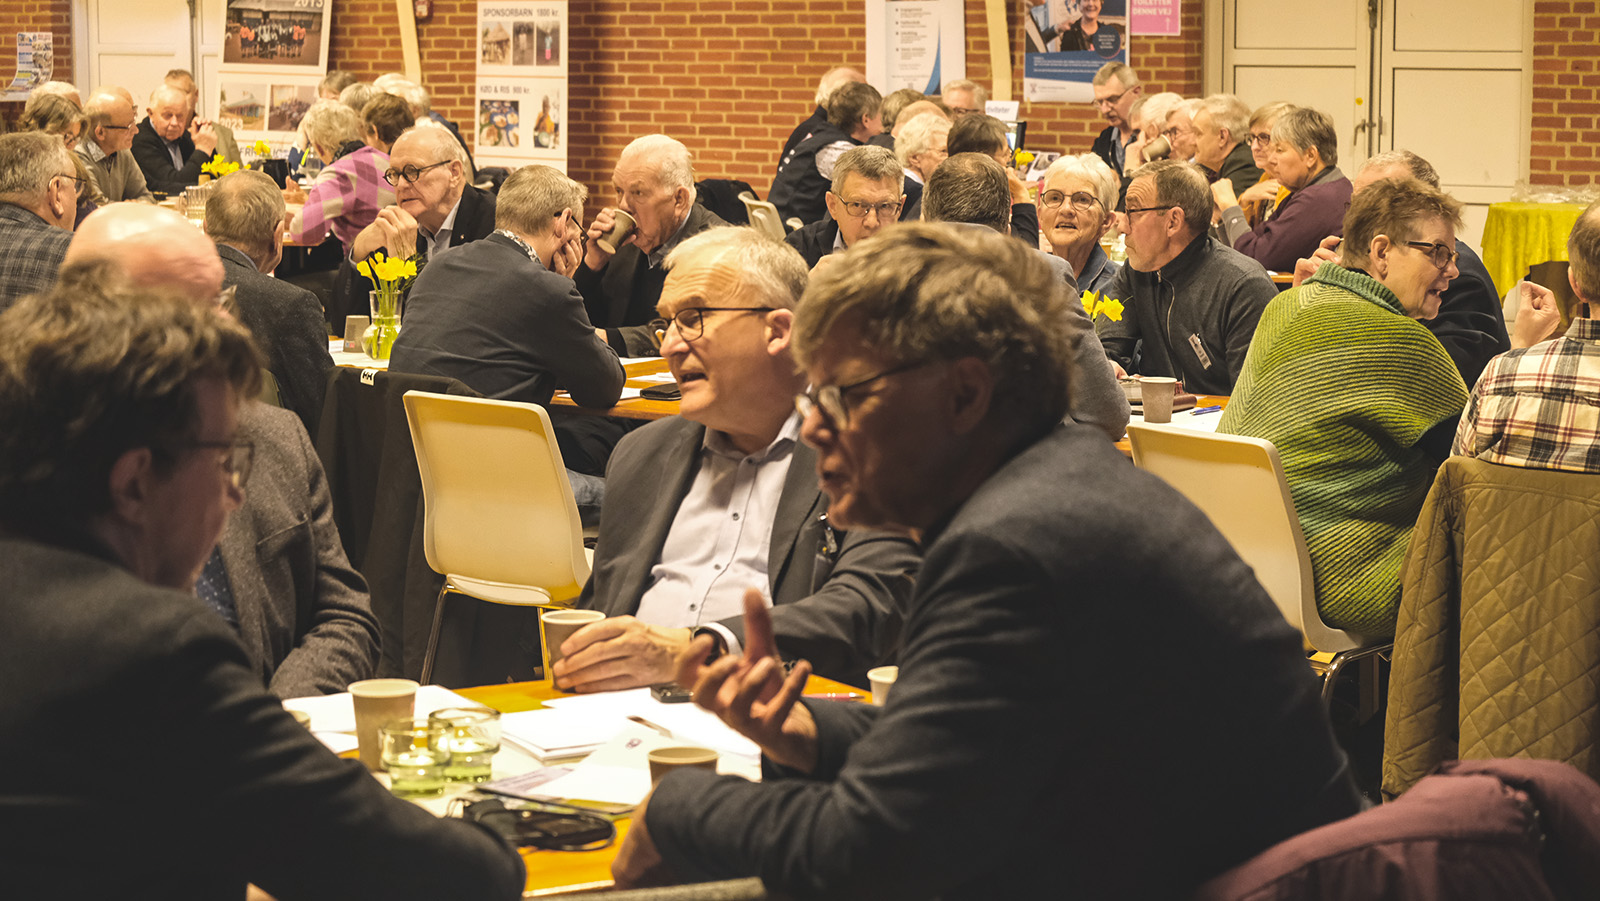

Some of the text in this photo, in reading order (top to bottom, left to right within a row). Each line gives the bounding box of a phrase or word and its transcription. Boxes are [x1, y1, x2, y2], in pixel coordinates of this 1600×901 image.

[483, 8, 533, 17] SPONSORBARN
[537, 8, 551, 17] 1800
[1132, 8, 1172, 16] DENNE VEJ
[986, 106, 1010, 114] tiviteter
[219, 117, 243, 130] 2023
